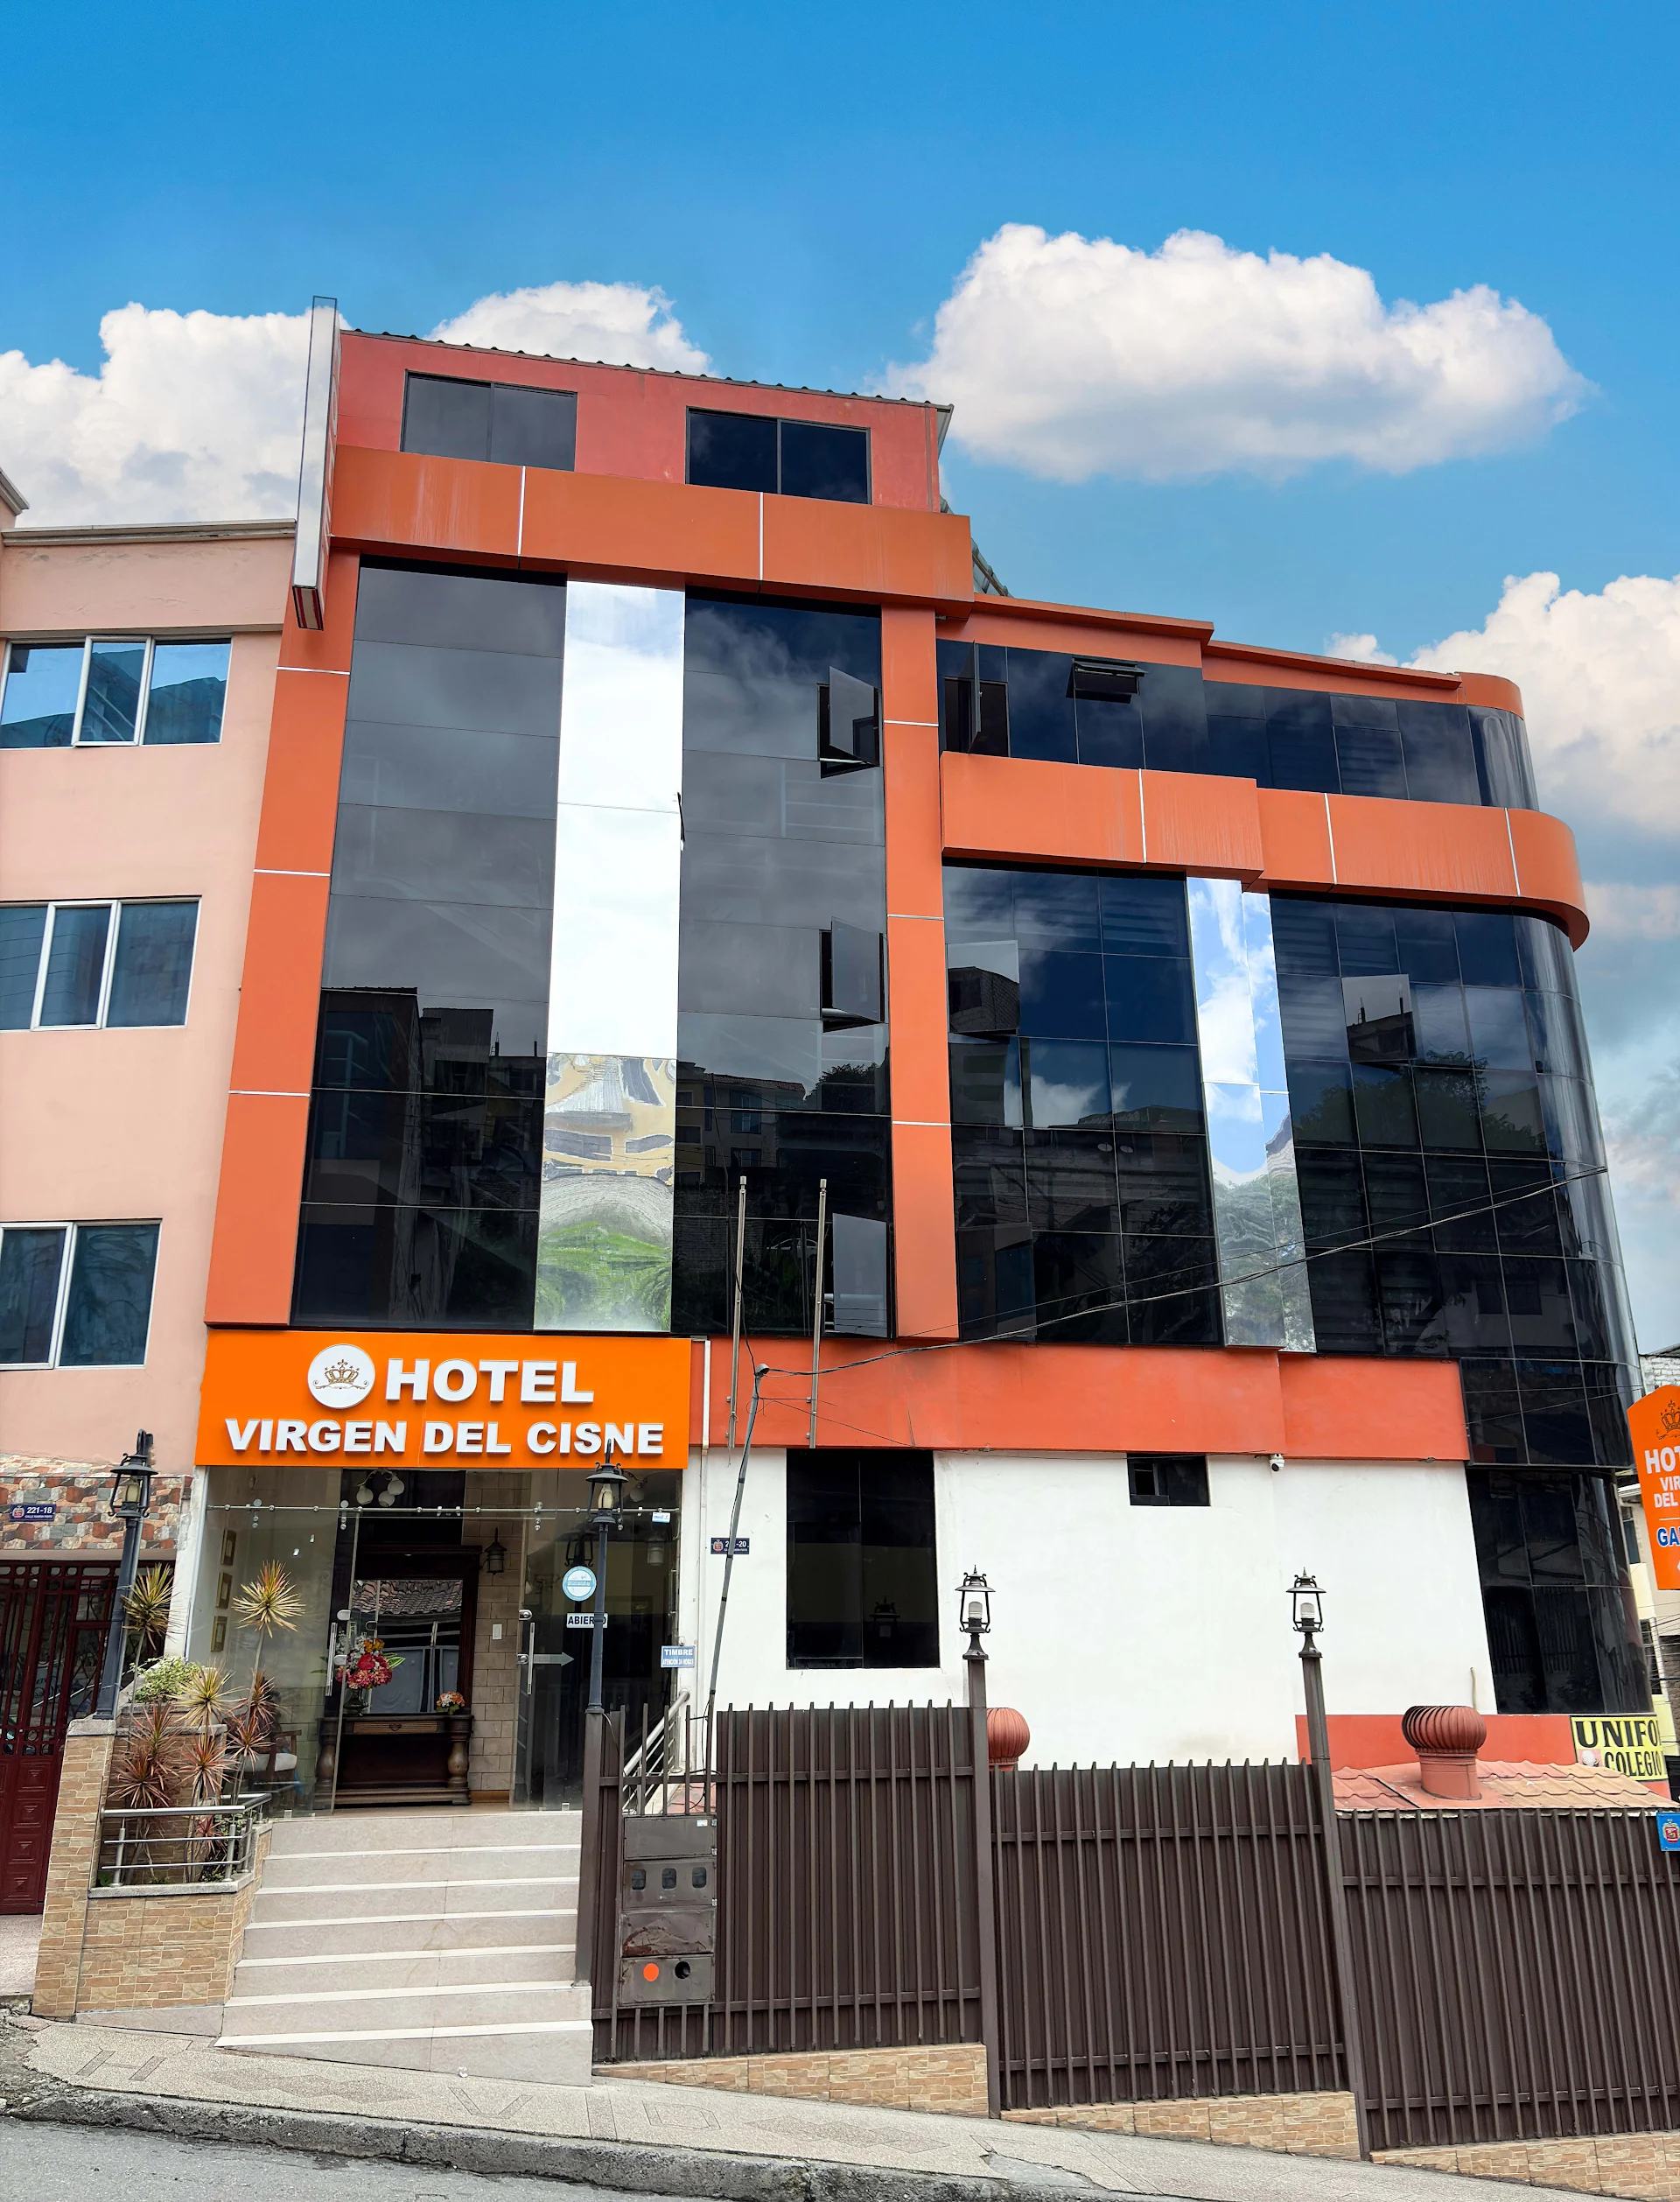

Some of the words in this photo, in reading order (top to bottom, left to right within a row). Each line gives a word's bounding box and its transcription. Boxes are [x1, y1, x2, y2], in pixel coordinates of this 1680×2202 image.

[385, 1358, 595, 1403] HOTEL
[225, 1418, 408, 1453] VIRGEN
[424, 1421, 512, 1454] DEL
[527, 1421, 664, 1455] CISNE
[1654, 1491, 1679, 1508] DEL
[1656, 1527, 1680, 1547] GA
[568, 1616, 606, 1625] ABIER
[1575, 1719, 1662, 1748] UNIFO
